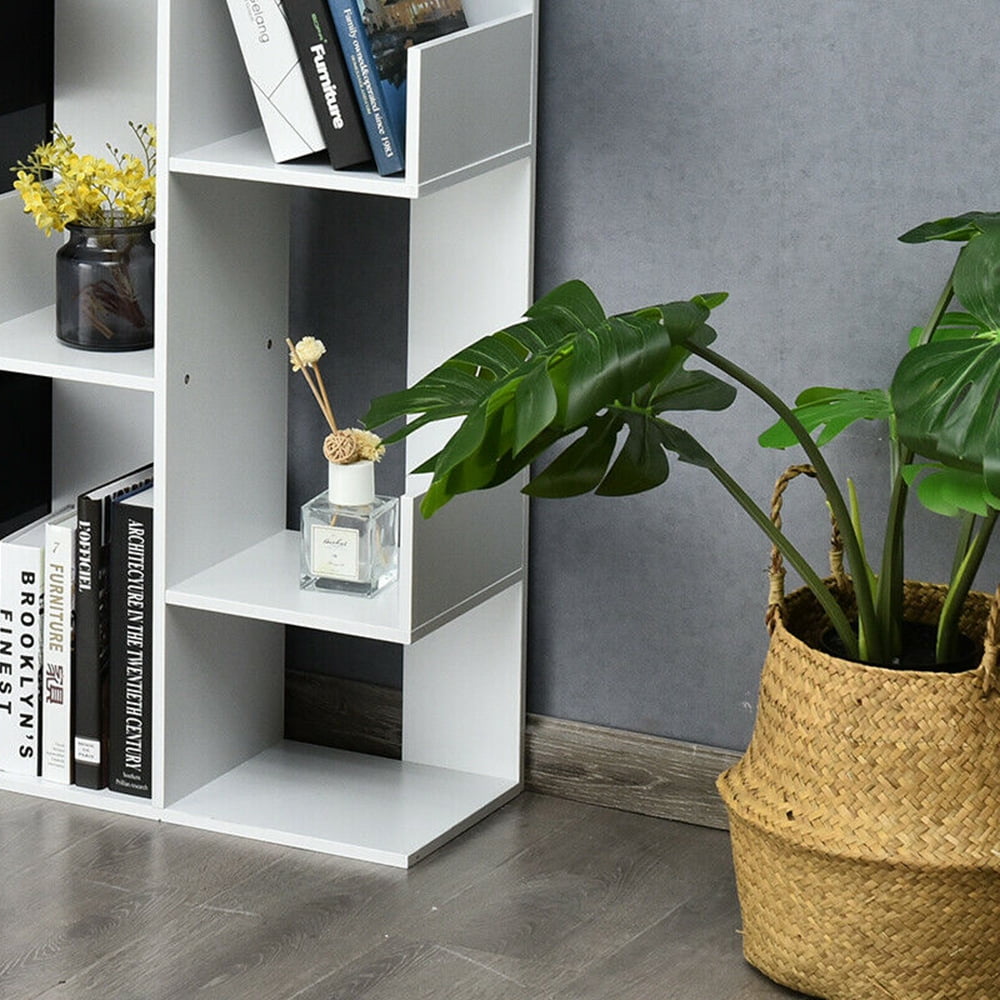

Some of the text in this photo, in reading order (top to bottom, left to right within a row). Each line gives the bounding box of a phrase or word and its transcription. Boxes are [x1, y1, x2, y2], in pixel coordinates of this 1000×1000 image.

[309, 43, 345, 130] Furniture
[342, 7, 358, 40] Family
[373, 111, 387, 136] since
[380, 135, 394, 160] 1983
[78, 519, 93, 593] L'OFFICIEL
[49, 562, 65, 653] FURNITURE
[127, 609, 145, 623] IN
[127, 624, 144, 647] THE
[18, 570, 36, 759] BROOKLYN'S
[45, 663, 65, 705] 家具
[125, 649, 144, 716] TWENTIETH
[124, 716, 143, 772] CENTURY
